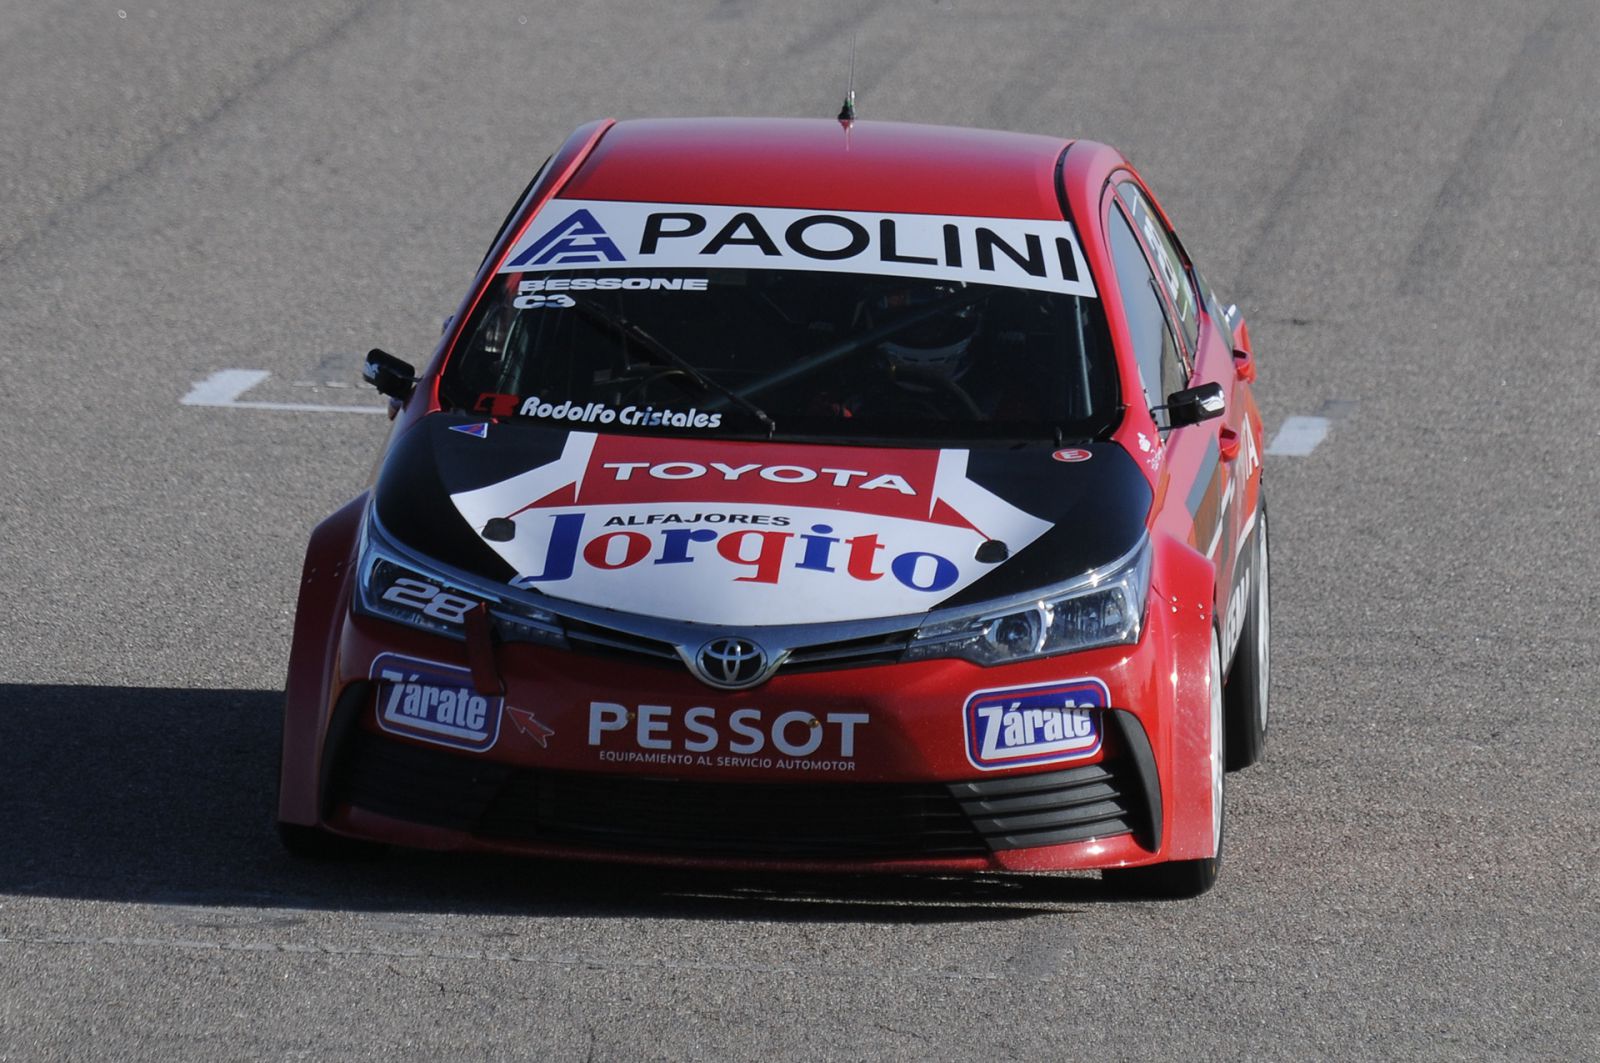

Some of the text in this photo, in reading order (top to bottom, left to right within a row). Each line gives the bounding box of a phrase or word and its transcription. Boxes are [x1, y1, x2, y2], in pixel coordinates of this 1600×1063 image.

[638, 211, 1080, 283] PAOLINI
[512, 293, 577, 309] C3
[517, 277, 709, 292] BESSONE
[519, 396, 616, 424] Rodolfo
[618, 405, 723, 429] Cristales
[602, 461, 918, 496] TOYOTA
[602, 512, 792, 528] ALFAJORES
[517, 512, 960, 593] Jorgito
[381, 577, 480, 624] 28
[382, 669, 489, 742] Zárate
[587, 701, 870, 757] PESSOT
[977, 699, 1097, 760] Zárate
[598, 750, 856, 772] EQUIPAMIENTO AL SERVICIO AUTOMOTOR
